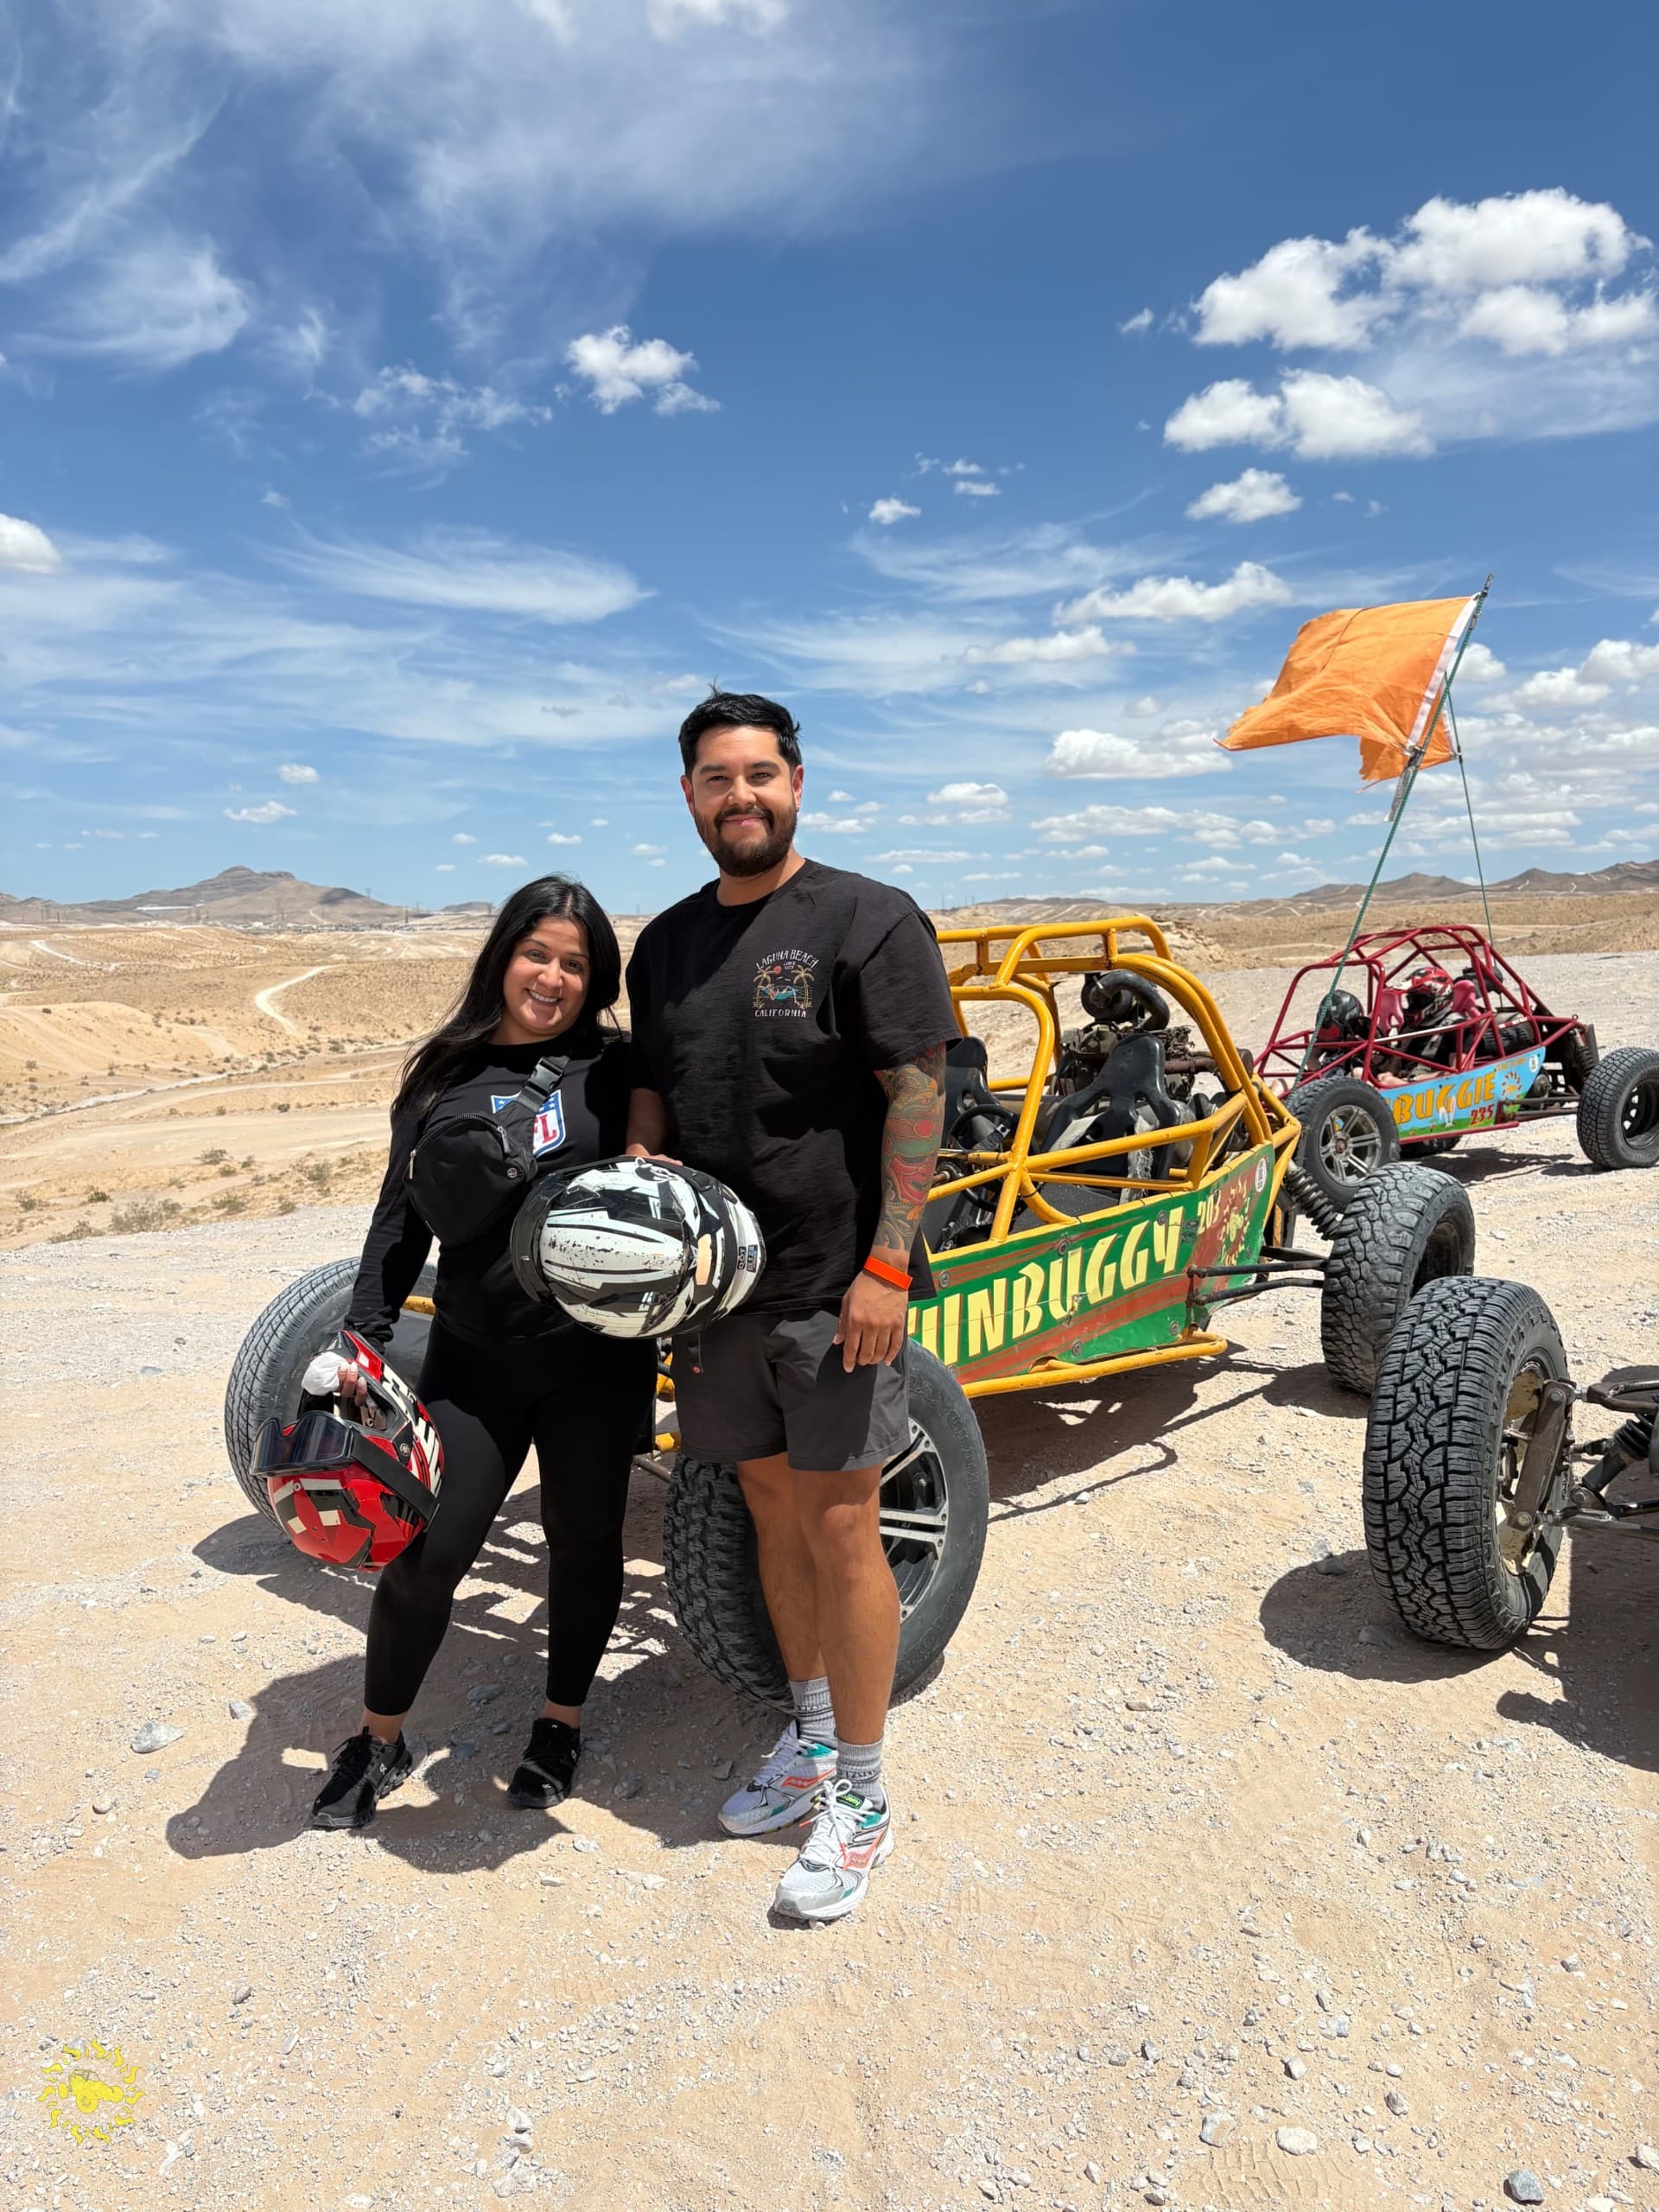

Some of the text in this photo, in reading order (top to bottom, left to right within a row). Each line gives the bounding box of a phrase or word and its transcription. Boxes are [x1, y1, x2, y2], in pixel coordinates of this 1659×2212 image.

[755, 950, 788, 970] LAGUNA
[790, 950, 820, 969] BEACH
[754, 1008, 807, 1018] CALIFORNIA
[1386, 1072, 1496, 1126] BUGGIE
[1470, 1103, 1495, 1127] 235
[1196, 1189, 1222, 1236] 203
[738, 1247, 747, 1270] DOT
